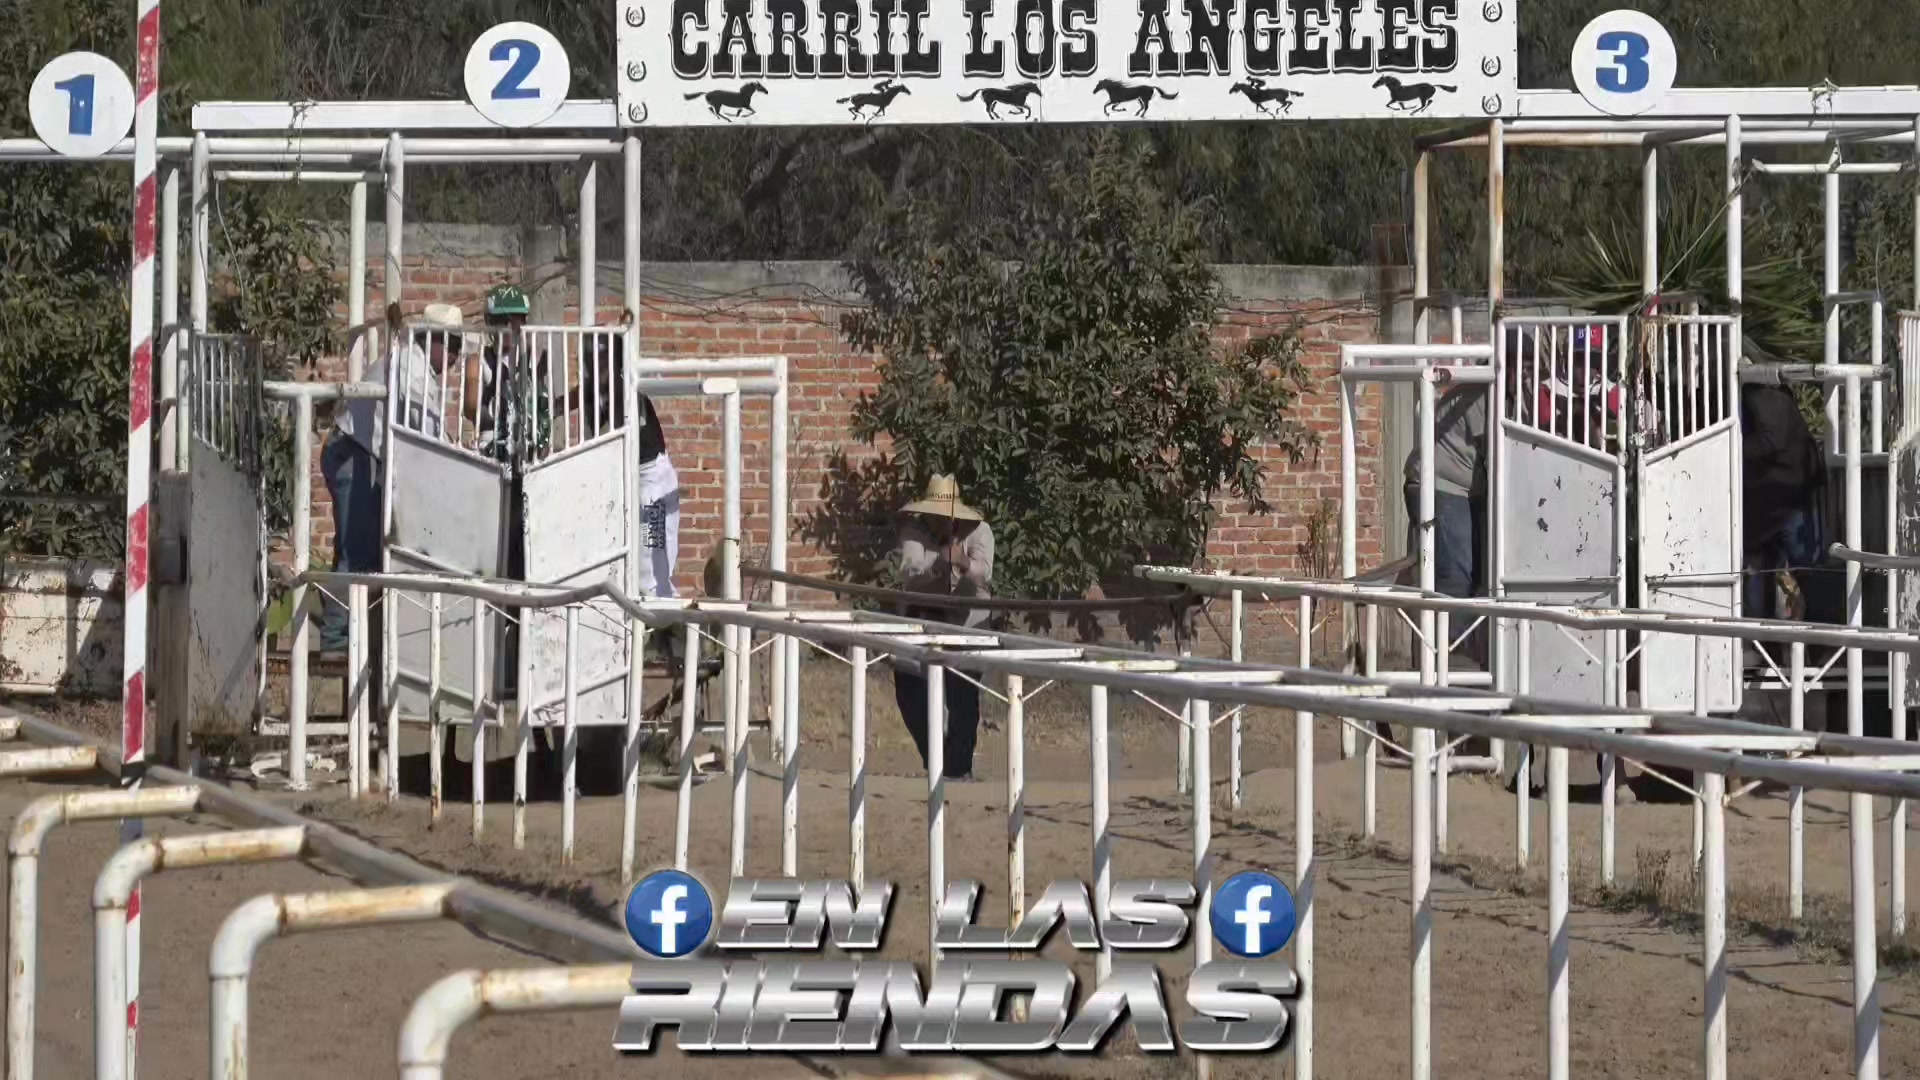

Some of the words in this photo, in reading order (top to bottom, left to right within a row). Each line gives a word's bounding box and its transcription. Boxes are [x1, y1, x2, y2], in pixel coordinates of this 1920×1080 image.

[489, 39, 541, 101] 2
[668, 0, 941, 78] CARRIL
[963, 0, 1098, 78] LOS
[1128, 0, 1459, 75] ANGELES
[1596, 31, 1650, 94] 3
[54, 74, 96, 136] 1
